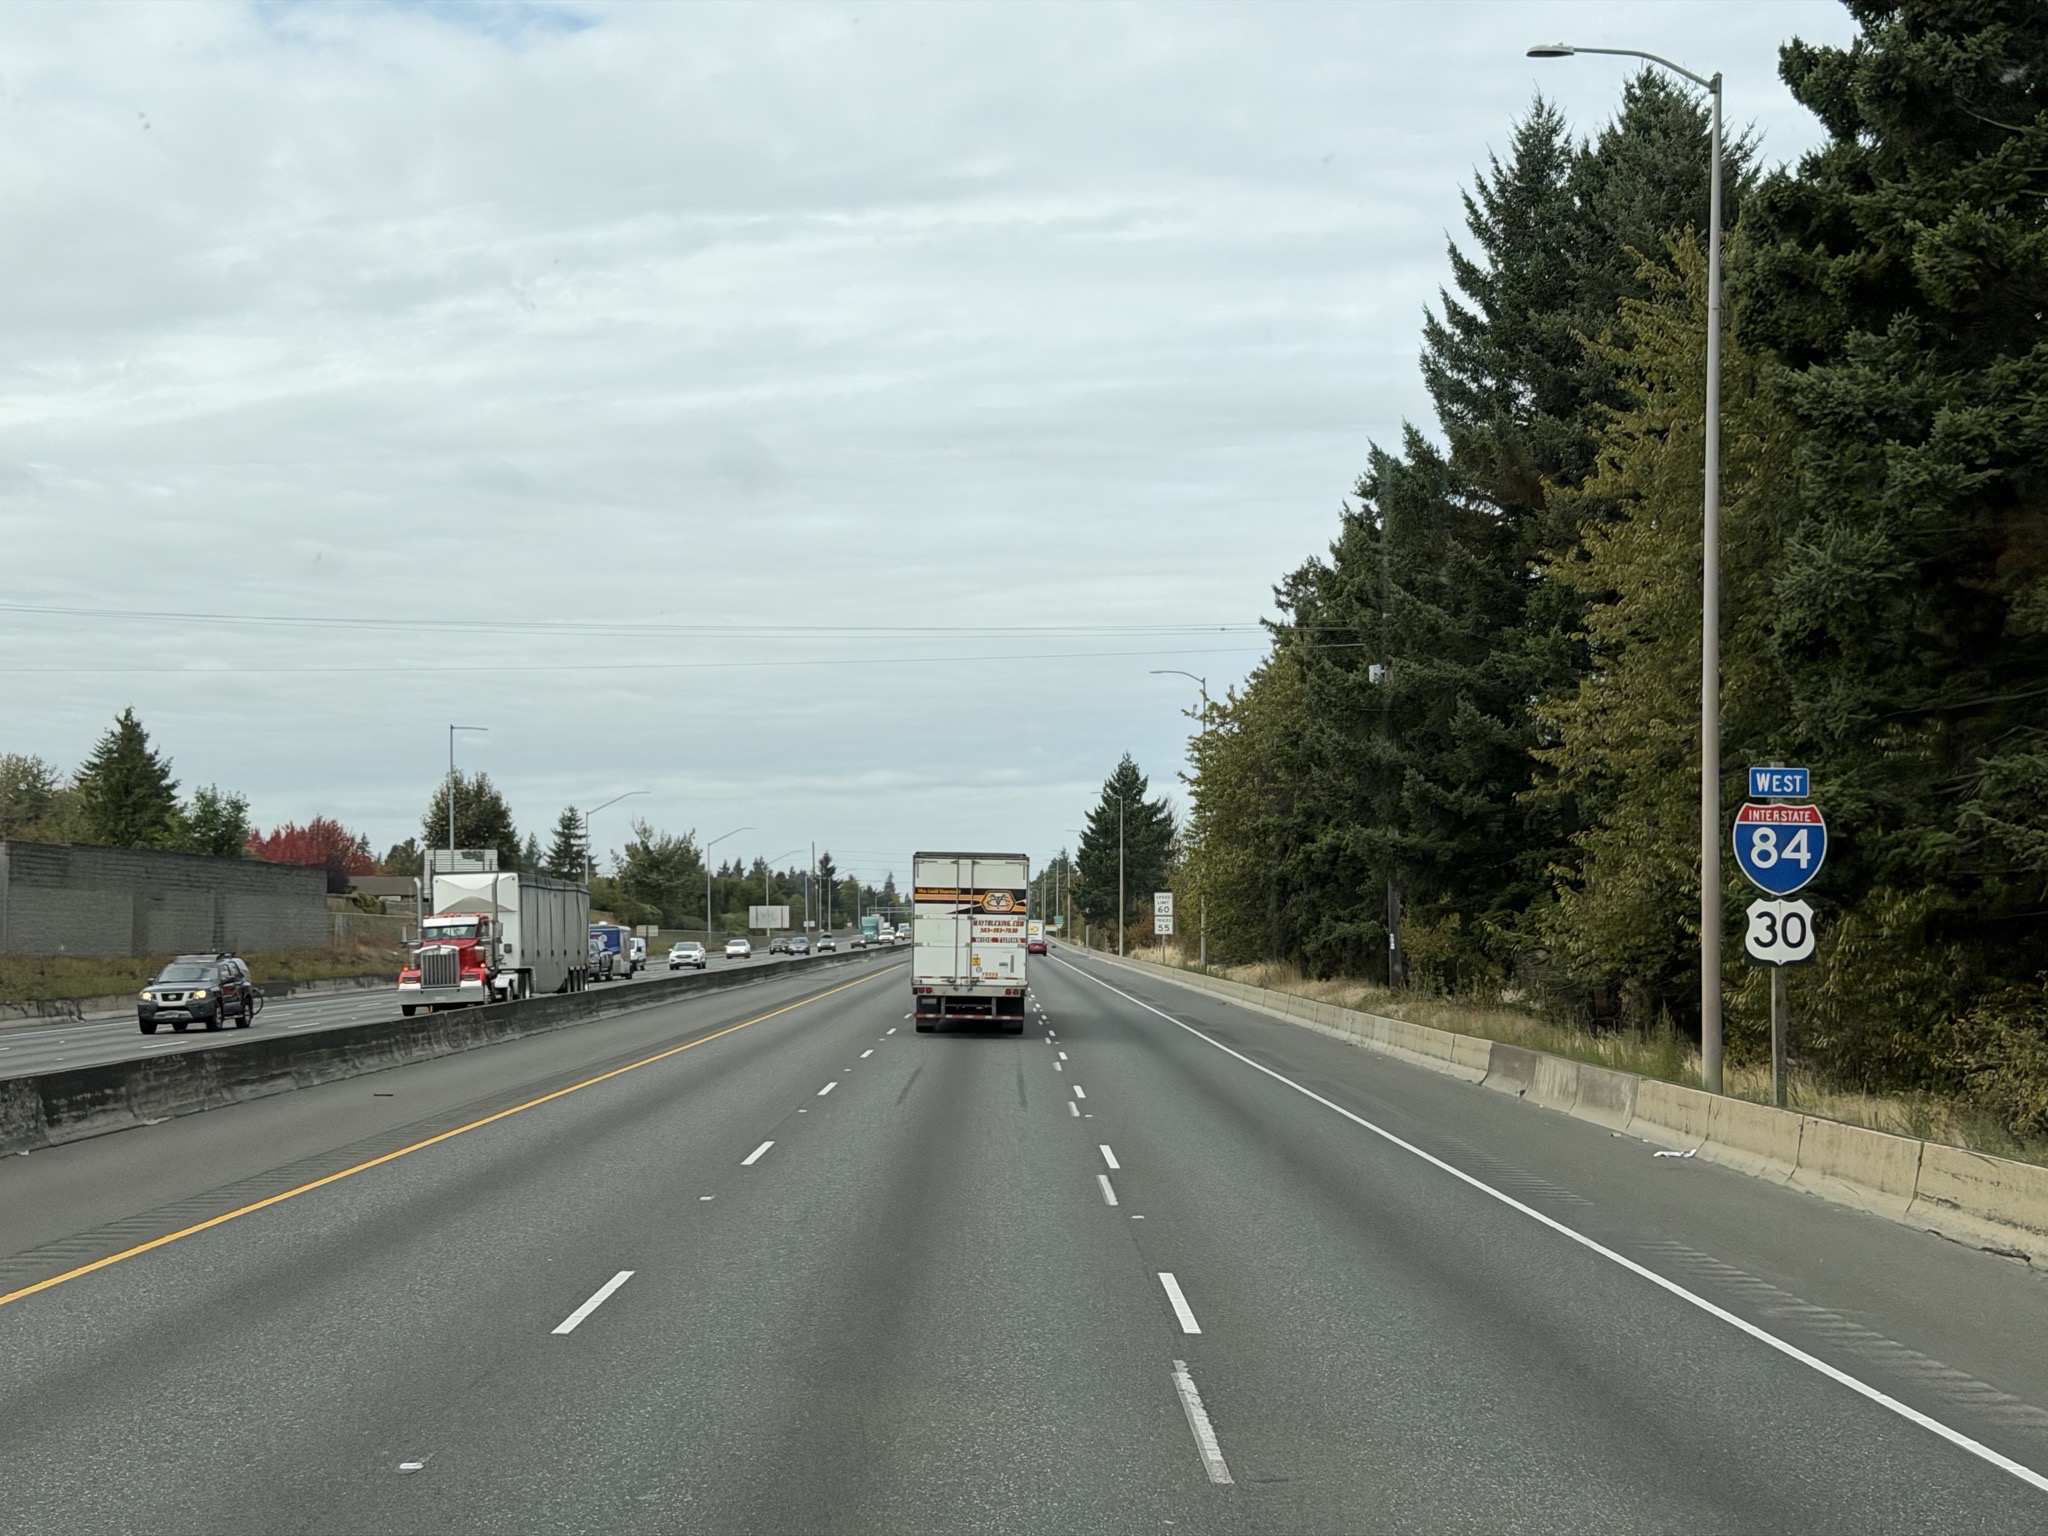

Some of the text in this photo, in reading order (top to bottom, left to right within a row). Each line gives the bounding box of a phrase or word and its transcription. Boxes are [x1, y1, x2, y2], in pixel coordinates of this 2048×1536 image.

[1756, 773, 1802, 793] WEST
[1748, 810, 1811, 822] INTERSTATE
[1750, 827, 1811, 869] 84
[1157, 924, 1170, 932] 55
[1753, 911, 1806, 949] 30
